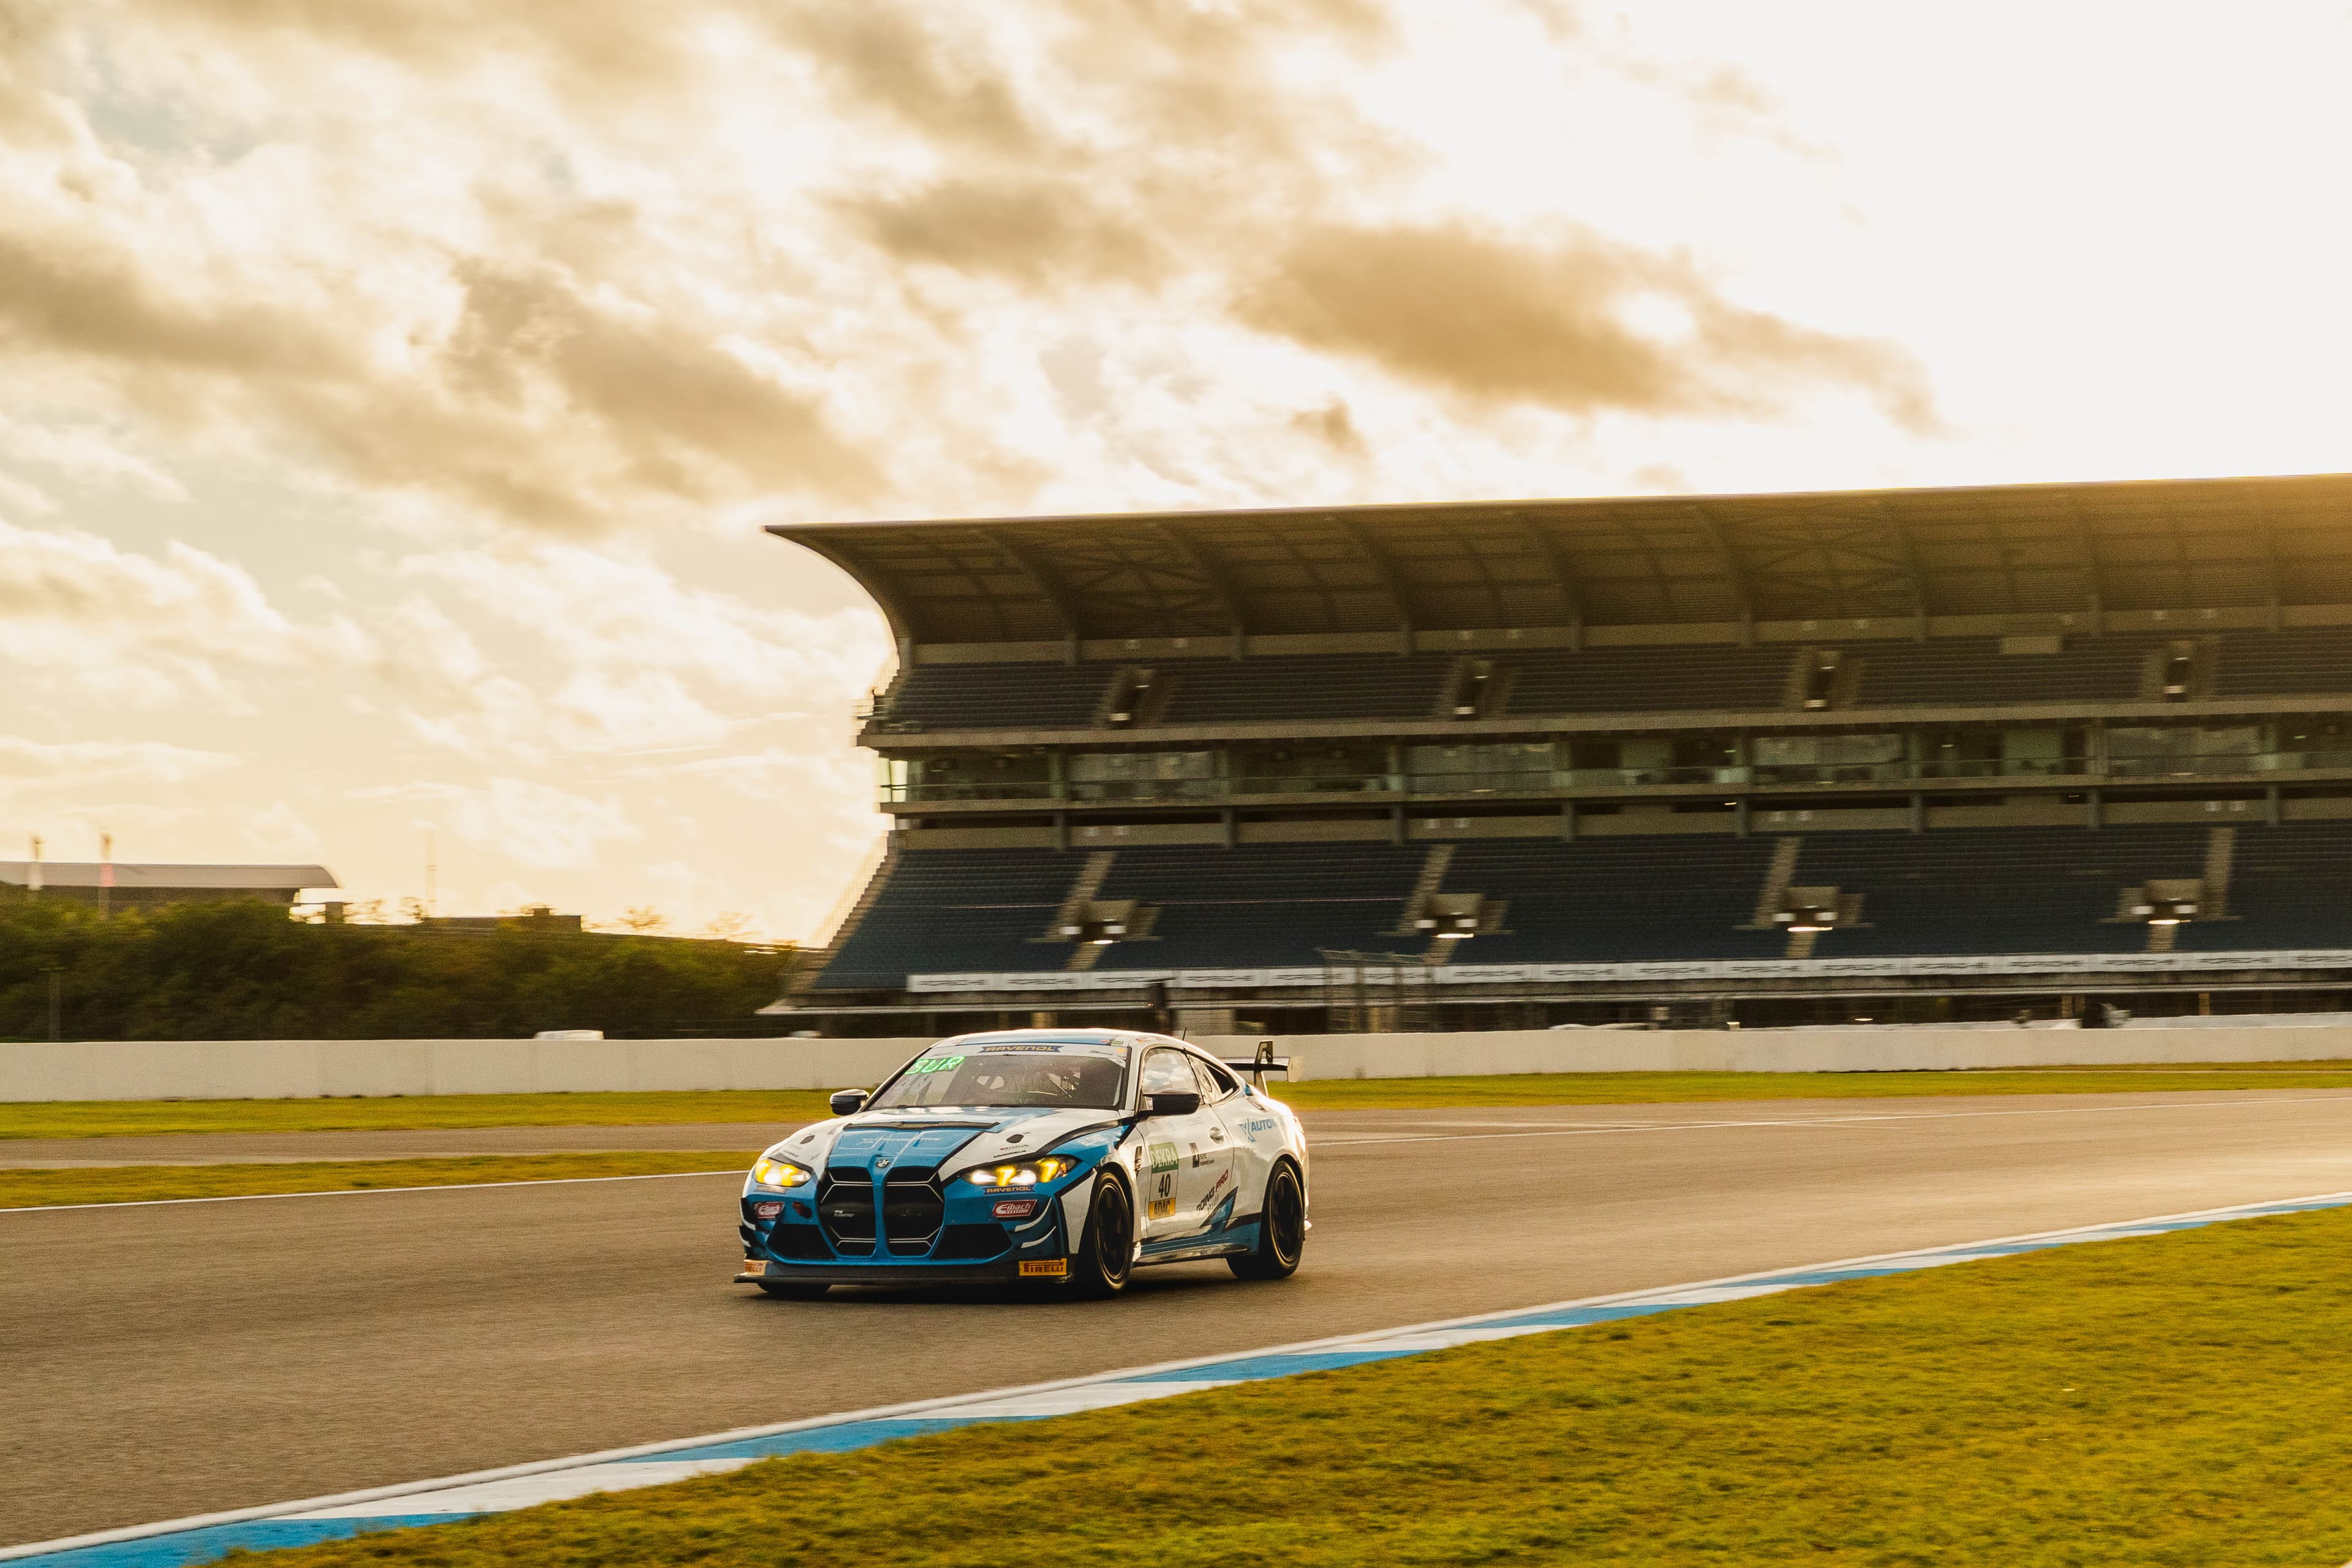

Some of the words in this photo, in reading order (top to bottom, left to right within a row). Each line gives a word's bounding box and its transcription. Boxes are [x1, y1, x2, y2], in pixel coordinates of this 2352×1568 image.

[1150, 1147, 1178, 1168] DEKRA
[1158, 1174, 1171, 1198] 40
[1215, 1169, 1229, 1193] PRO
[996, 1202, 1031, 1214] Eibach
[1153, 1200, 1170, 1218] ADAC
[1023, 1262, 1063, 1273] PIRELLI
